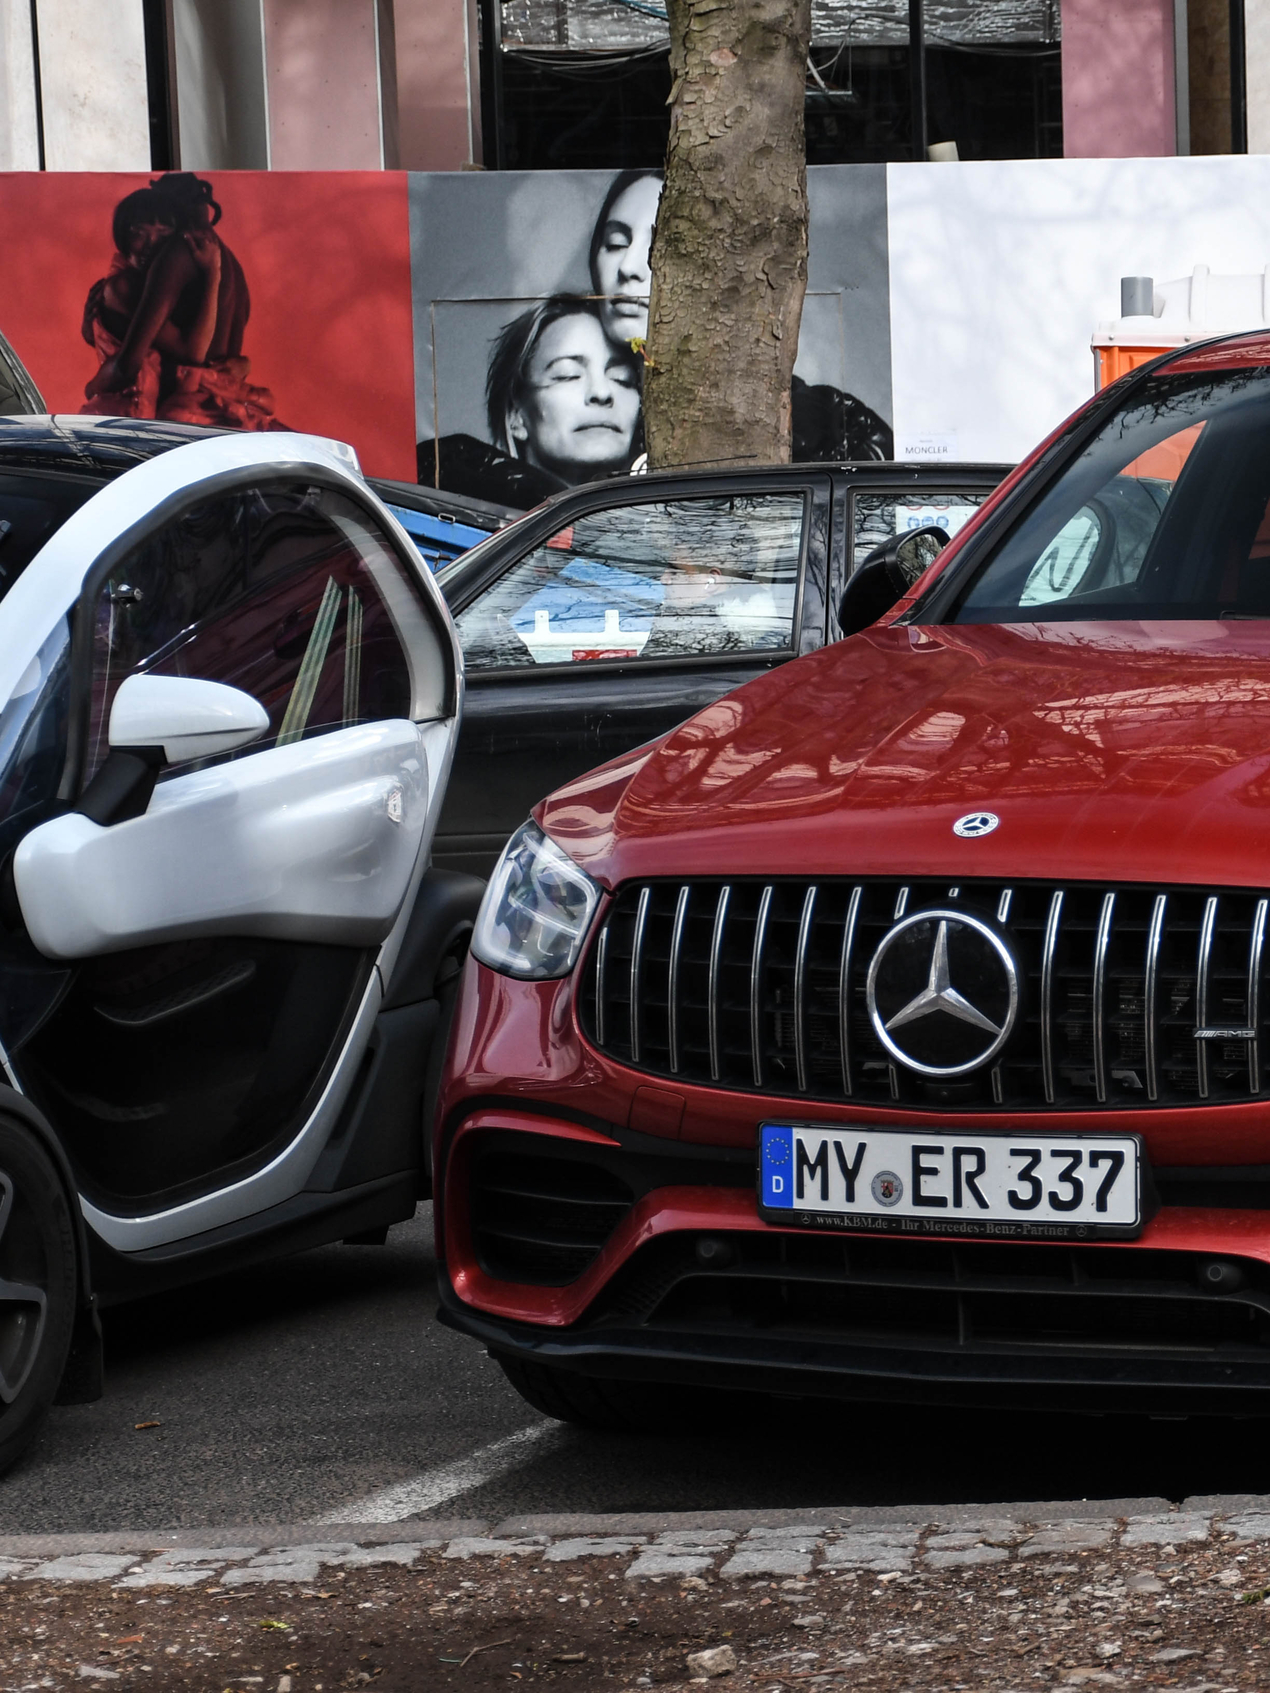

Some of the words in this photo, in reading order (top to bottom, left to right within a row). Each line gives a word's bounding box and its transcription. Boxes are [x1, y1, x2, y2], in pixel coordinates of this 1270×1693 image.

[905, 446, 948, 454] MONCLER
[772, 1176, 784, 1193] D
[796, 1138, 867, 1203] MY
[912, 1145, 990, 1209] ER
[1007, 1148, 1125, 1213] 337
[816, 1215, 888, 1229] www.KBM.de
[901, 1219, 919, 1230] Ihr
[922, 1220, 1069, 1236] Mercedes-Benz-Partner
